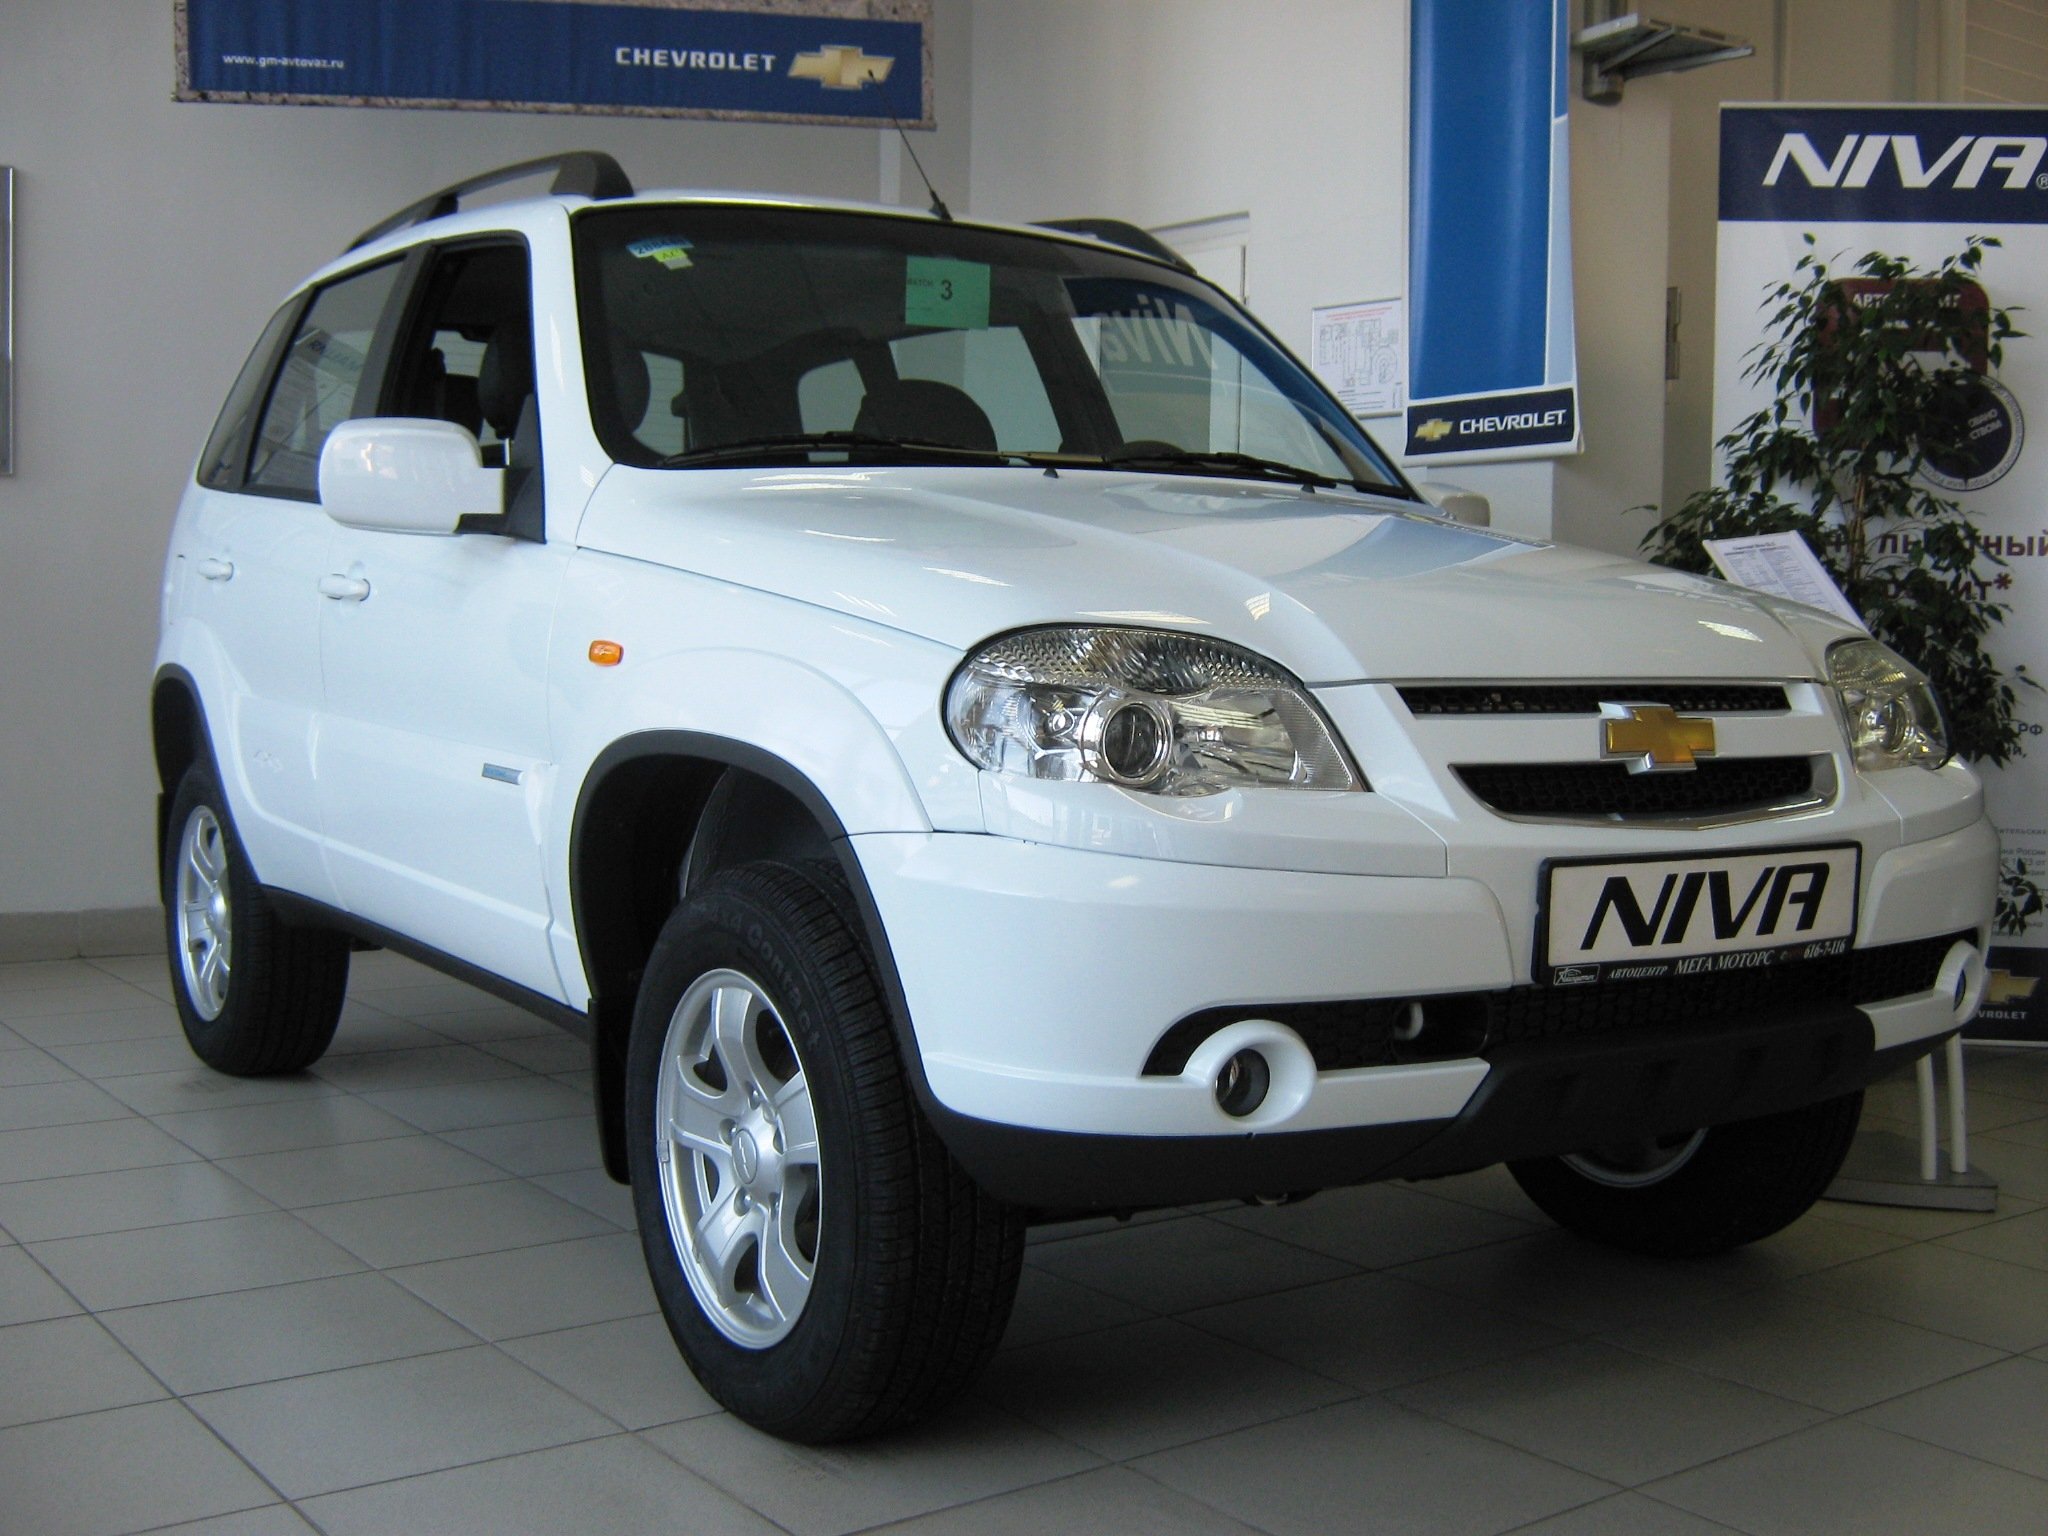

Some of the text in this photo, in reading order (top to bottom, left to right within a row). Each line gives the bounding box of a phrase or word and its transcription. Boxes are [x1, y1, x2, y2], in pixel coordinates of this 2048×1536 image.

[222, 54, 344, 68] www.gm-avtovaz.ru
[615, 47, 776, 72] CHEVROLET
[1761, 133, 2047, 189] NIVA
[940, 280, 953, 300] 3
[1460, 409, 1567, 434] CHEVROLET
[1580, 862, 1830, 950] NIVA
[1607, 965, 1668, 979] АВТОЦЕНТР
[1674, 956, 1713, 975] МЕГА
[1715, 950, 1776, 970] МОТОРС
